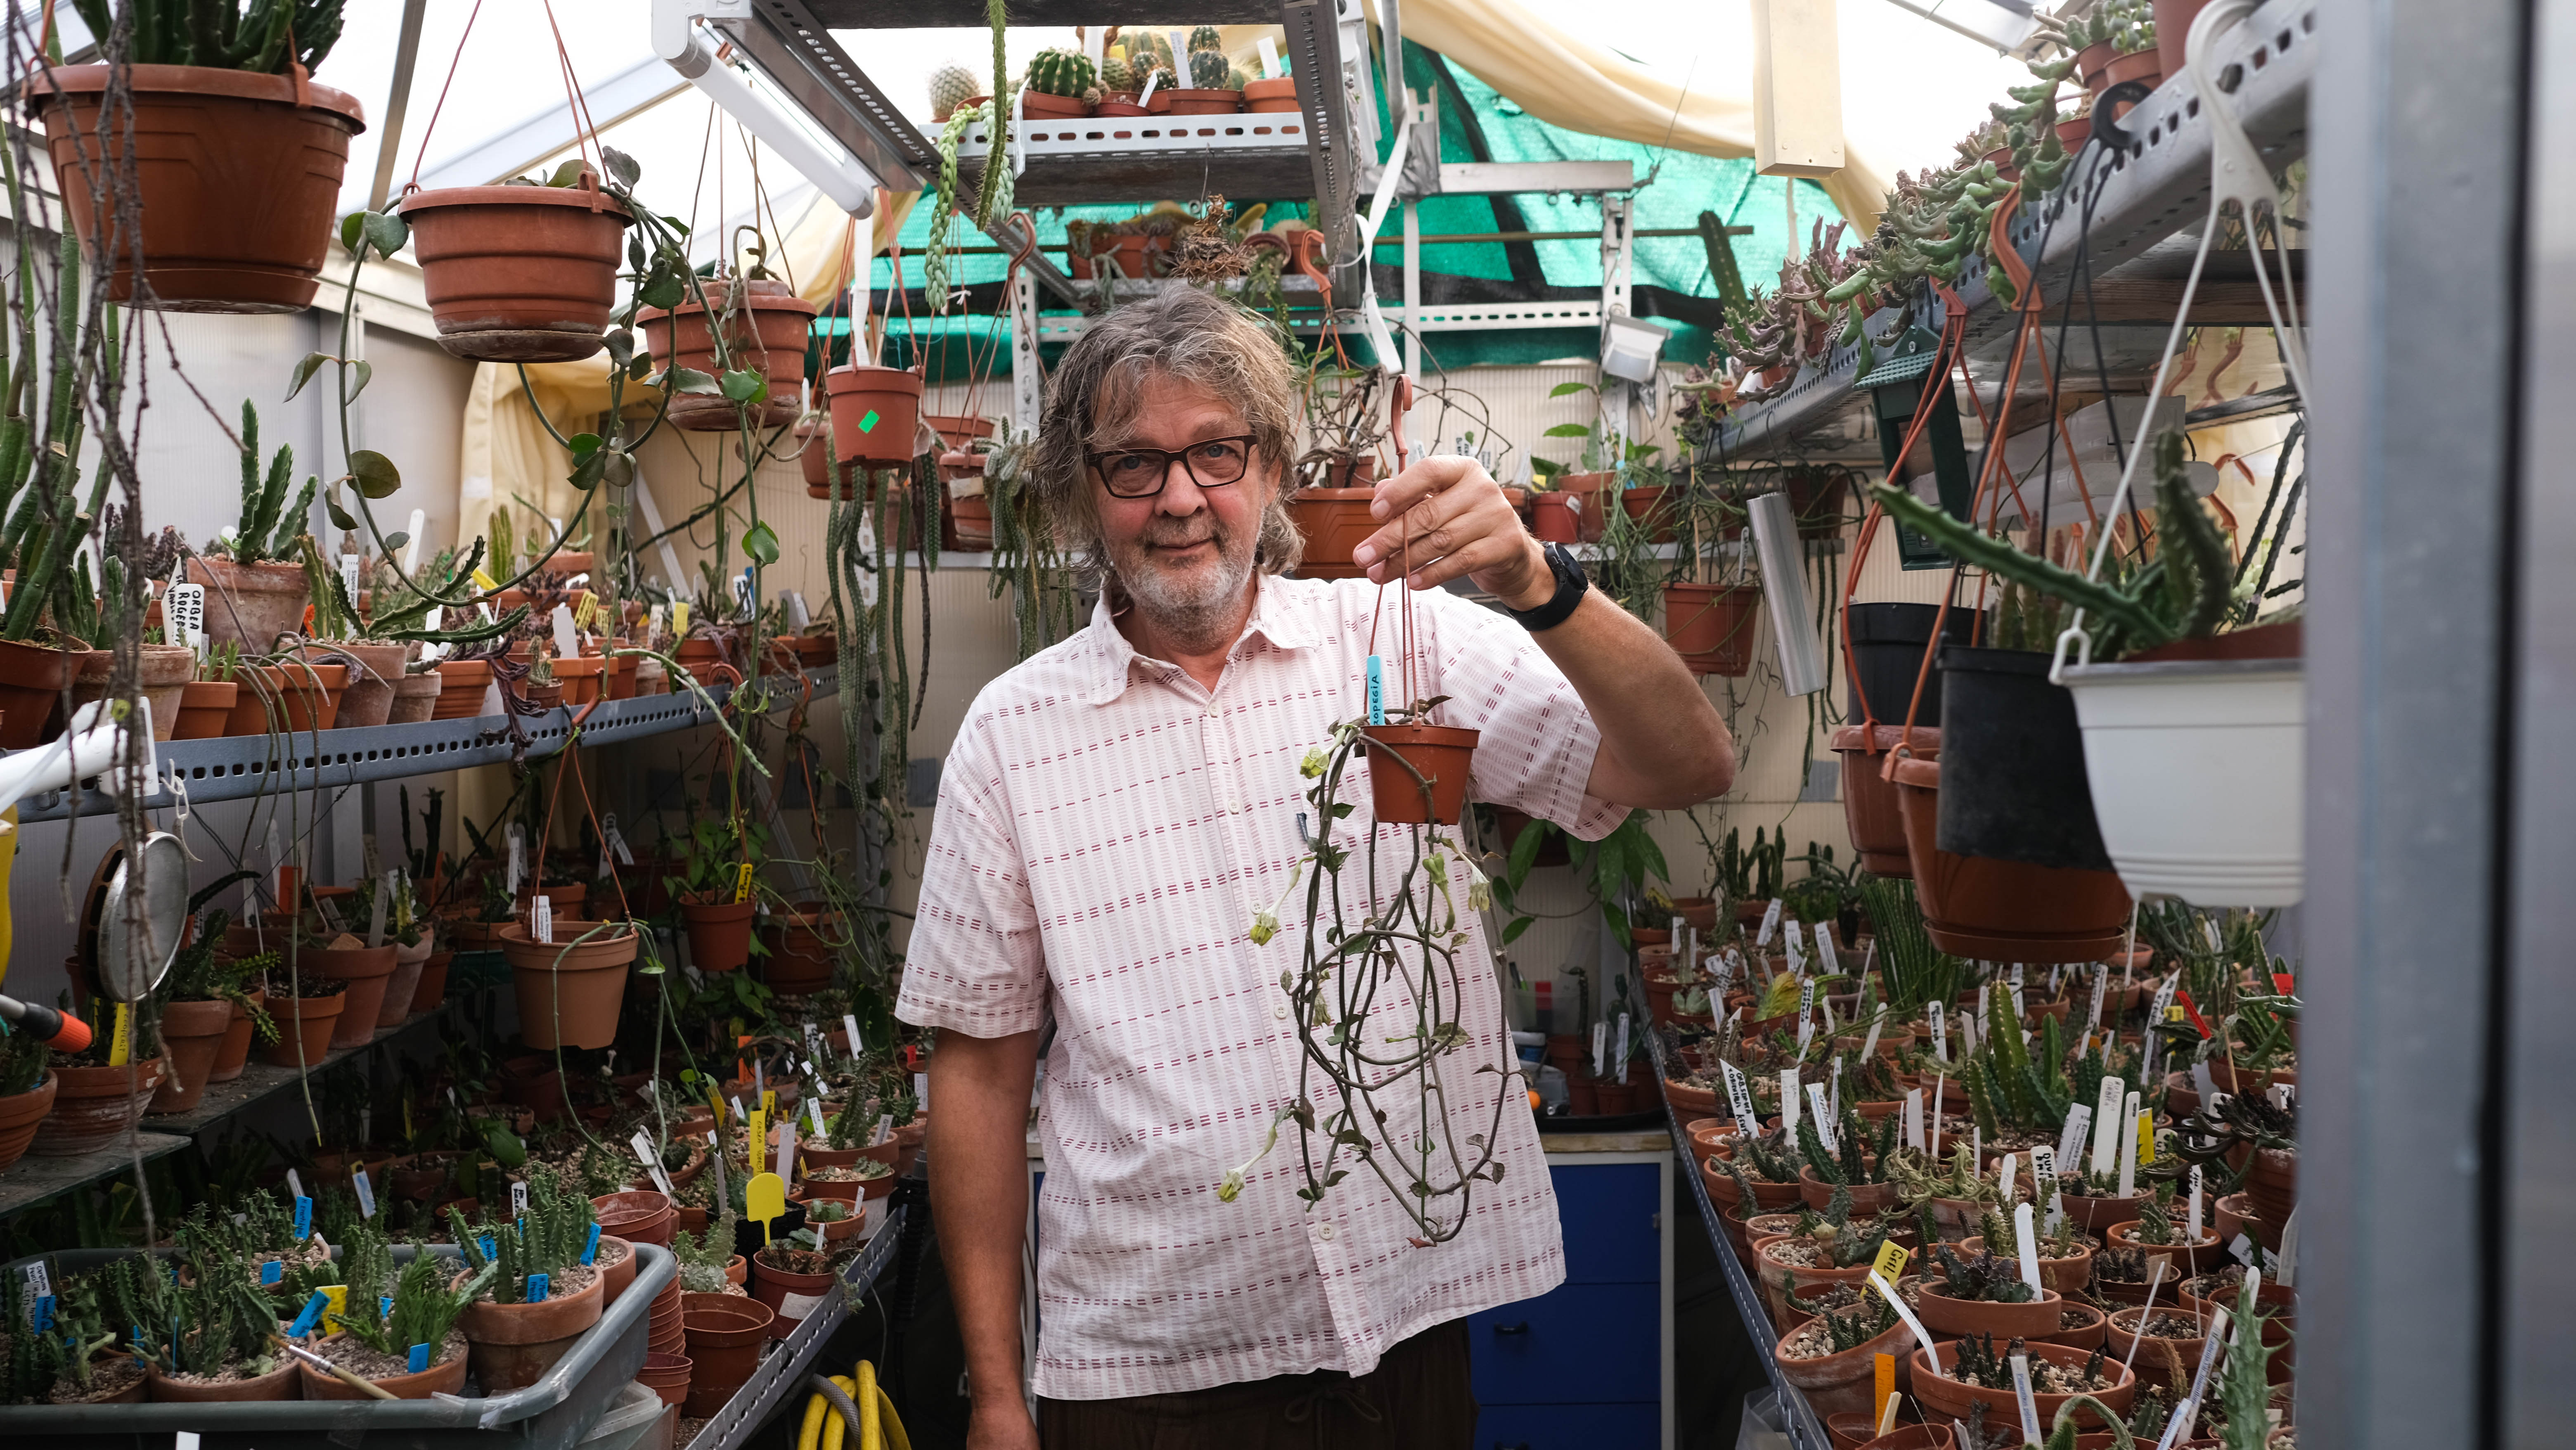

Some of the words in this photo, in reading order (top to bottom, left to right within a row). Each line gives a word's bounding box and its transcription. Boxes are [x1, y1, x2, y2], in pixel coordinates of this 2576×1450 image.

[176, 592, 189, 633] ROGER
[189, 590, 201, 630] ORBEA
[1371, 674, 1380, 725] ROPEGIA
[2042, 1153, 2054, 1181] DUVA
[1884, 1249, 1903, 1273] GEEL
[2165, 1411, 2181, 1437] aralluma
